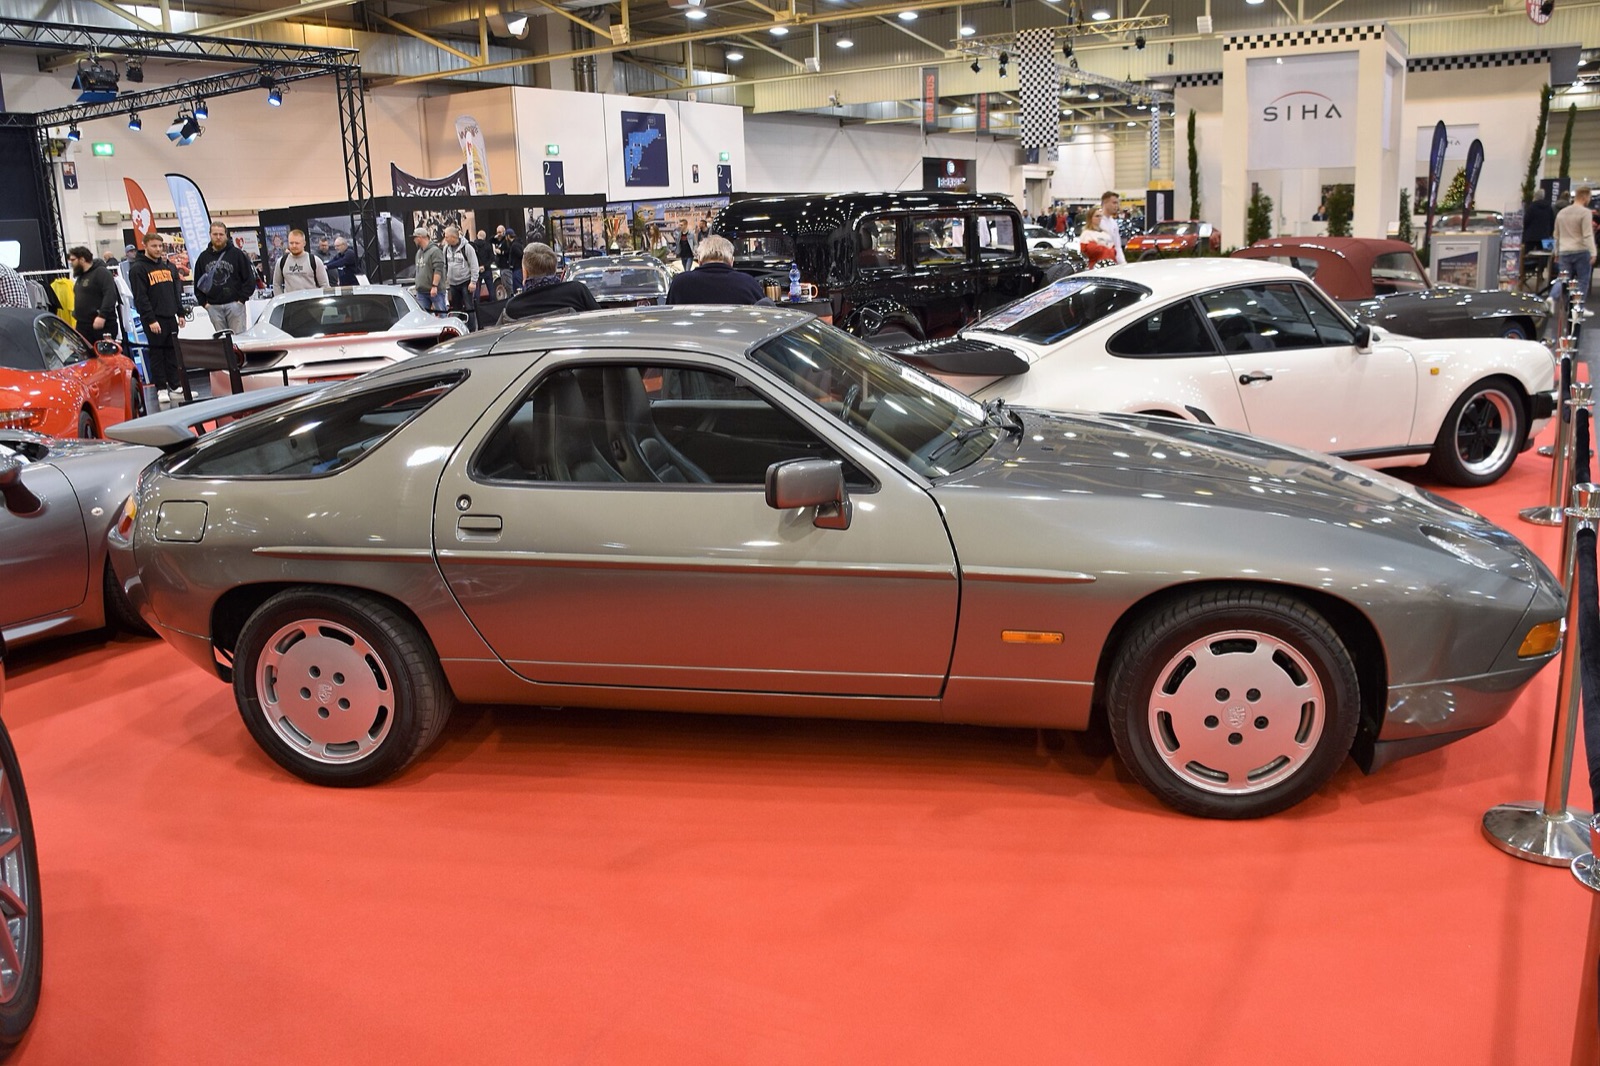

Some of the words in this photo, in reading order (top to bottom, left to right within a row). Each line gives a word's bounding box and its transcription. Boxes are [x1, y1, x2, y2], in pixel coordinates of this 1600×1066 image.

[1263, 104, 1342, 122] SIHA
[544, 162, 551, 176] 2
[717, 165, 723, 177] 2
